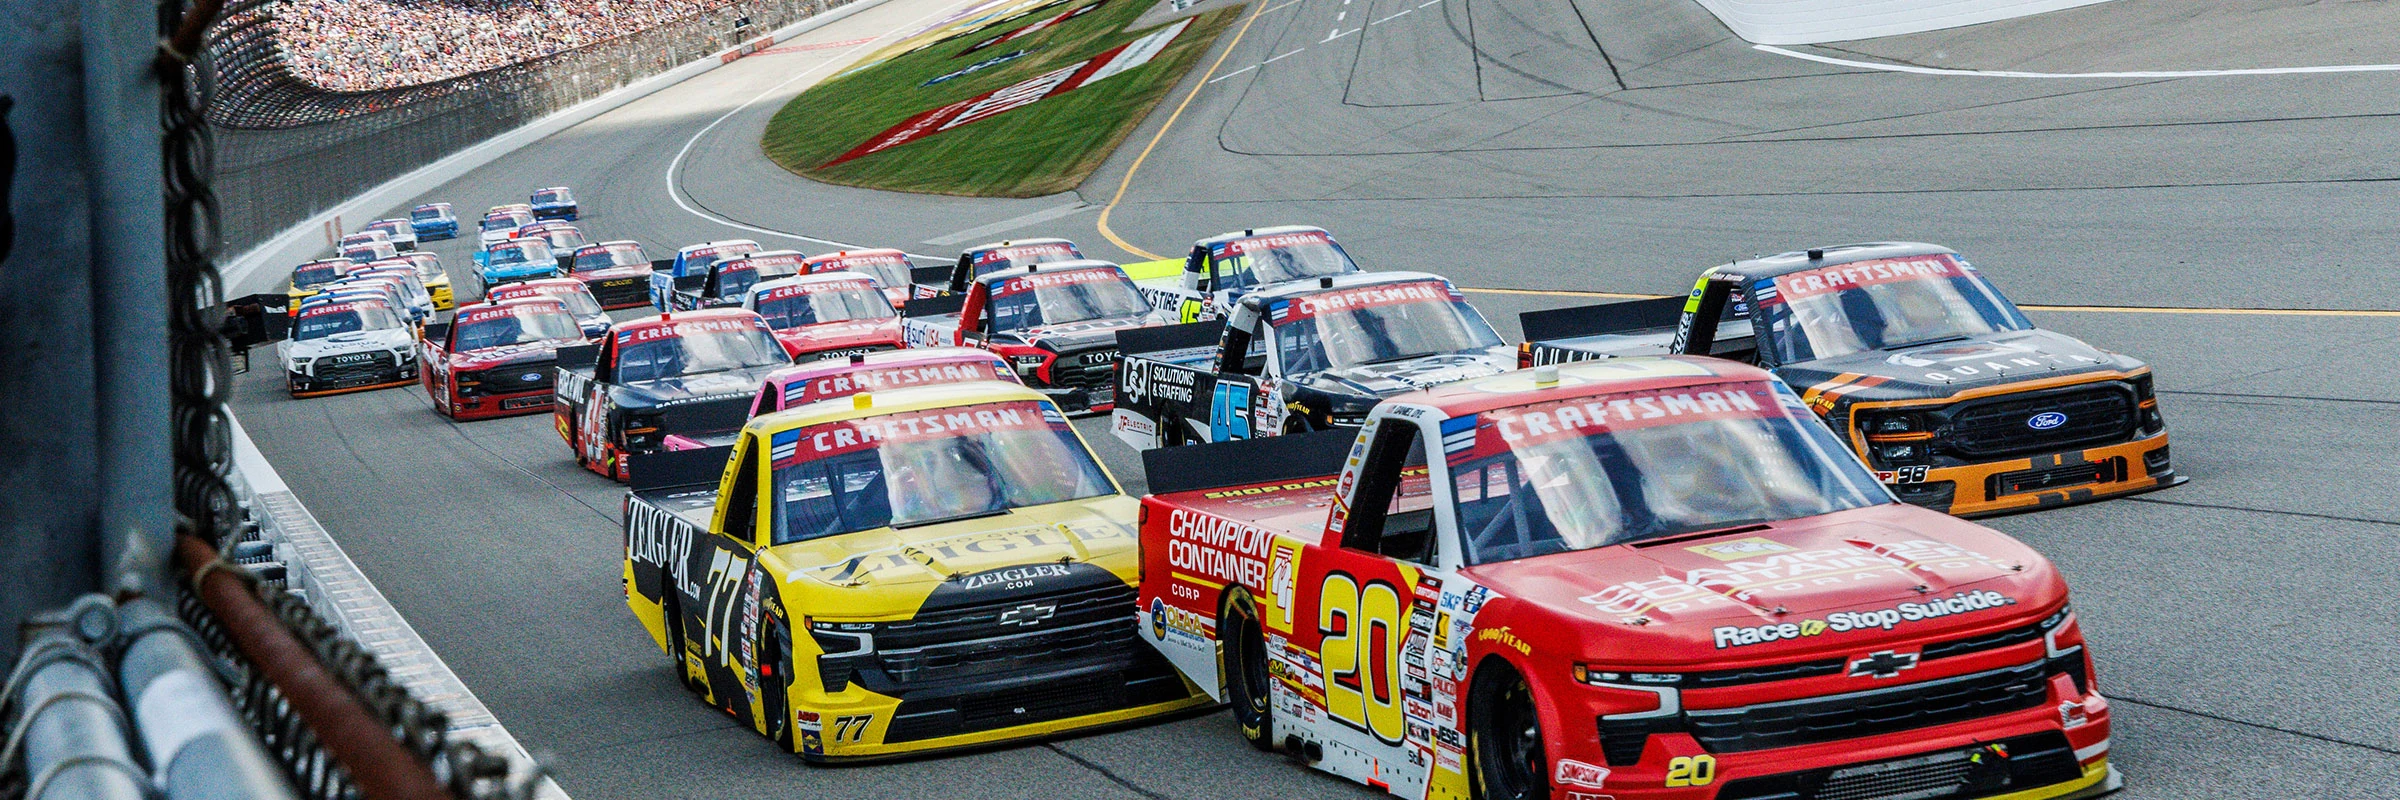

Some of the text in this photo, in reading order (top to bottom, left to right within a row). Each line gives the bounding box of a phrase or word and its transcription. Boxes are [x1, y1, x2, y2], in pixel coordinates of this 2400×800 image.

[987, 246, 1064, 261] CRAFTSMAN
[1231, 233, 1318, 252] CRAFTSMAN
[1010, 271, 1109, 292] CRAFTSMAN
[1789, 260, 1949, 294] CRAFTSMAN
[775, 281, 860, 298] CRAFTSMAN
[1299, 286, 1438, 315] CRAFTSMAN
[472, 305, 551, 320] CRAFTSMAN
[1160, 293, 1180, 312] TIRE
[638, 320, 744, 340] CRAFTSMAN
[335, 353, 373, 363] TOYOTA
[819, 364, 981, 396] CRAFTSMAN
[1152, 366, 1195, 386] SOLUTIONS
[1152, 387, 1193, 403] & STAFFING
[1210, 380, 1251, 443] 45
[1496, 390, 1760, 441] CRAFTSMAN
[2035, 414, 2060, 427] Ford
[813, 408, 1024, 452] CRAFTSMAN
[1897, 464, 1930, 484] 98
[1169, 509, 1275, 559] CHAMPION
[1169, 539, 1267, 591] CONTAINER
[962, 564, 1071, 590] ZEIGLER
[1005, 579, 1034, 590] .COM
[1172, 583, 1200, 600] CORP
[1440, 591, 1461, 610] SKF
[705, 545, 748, 668] 77
[1713, 621, 1800, 649] Race
[1799, 619, 1828, 636] to
[1826, 608, 1901, 632] Stop
[1478, 625, 1532, 657] GOODYEAR
[1319, 570, 1406, 748] 20
[834, 713, 874, 743] 77
[1436, 725, 1462, 748] JESEL
[1665, 754, 1716, 788] 20
